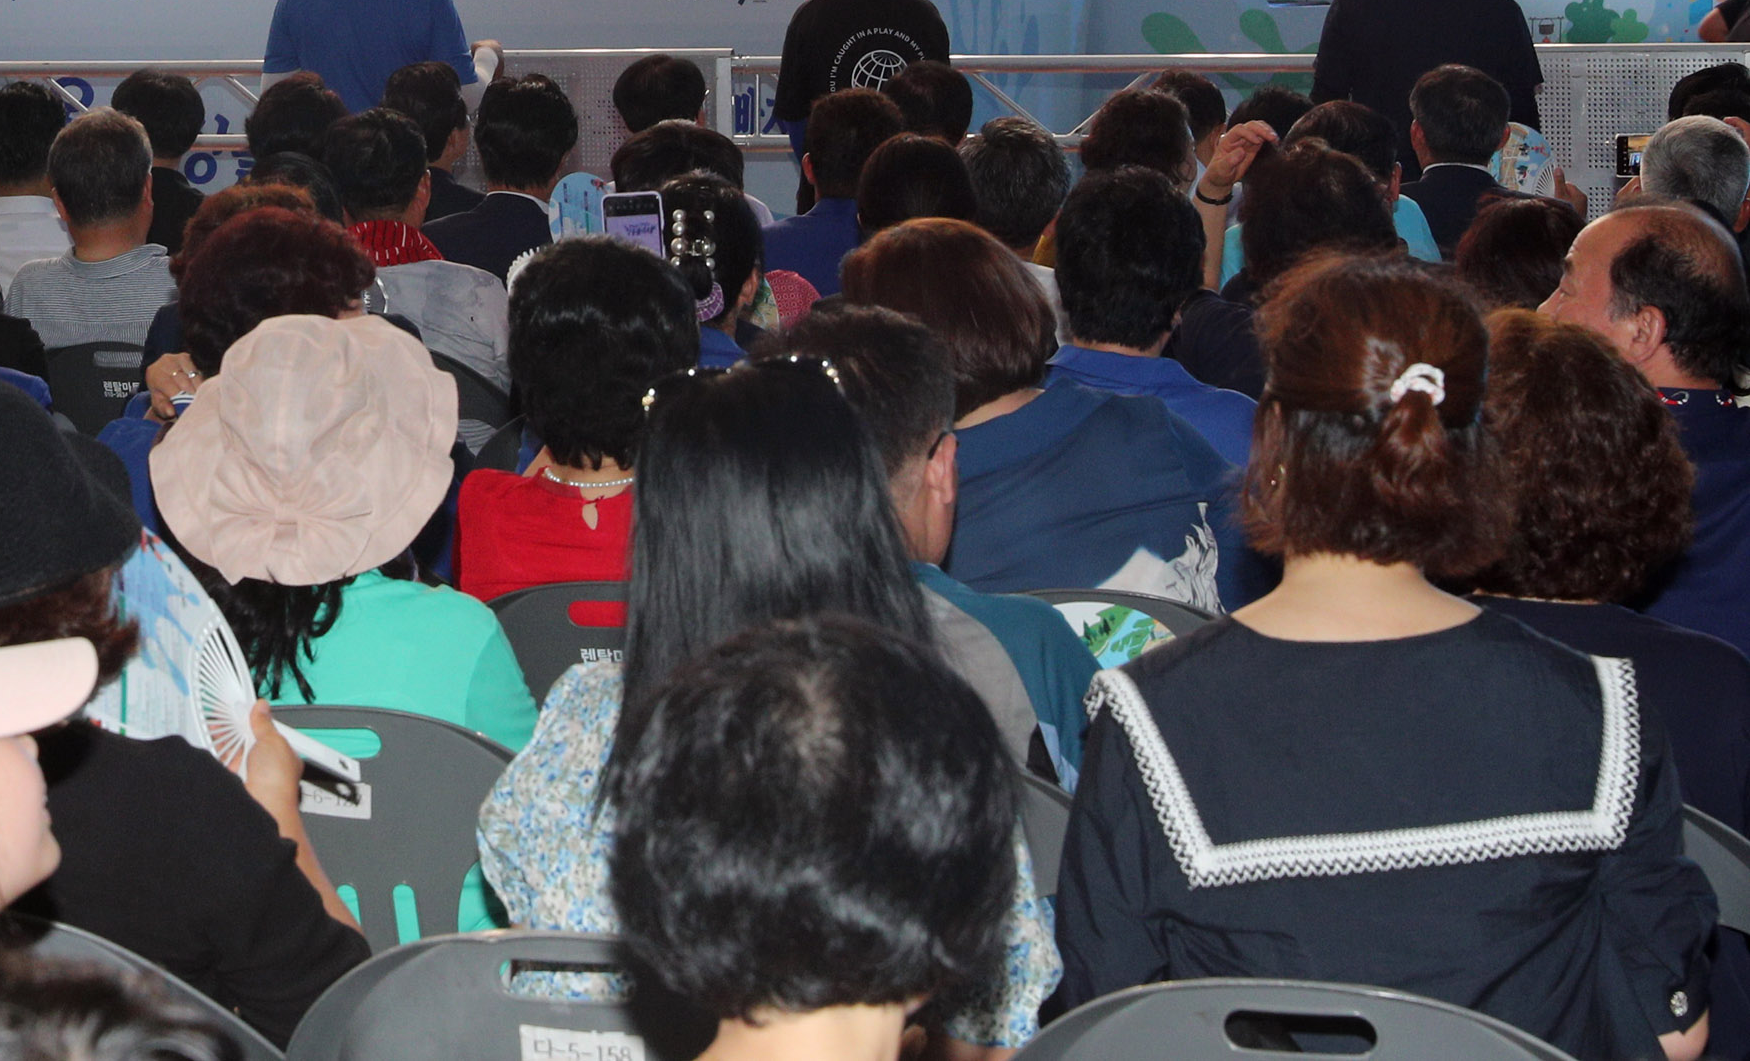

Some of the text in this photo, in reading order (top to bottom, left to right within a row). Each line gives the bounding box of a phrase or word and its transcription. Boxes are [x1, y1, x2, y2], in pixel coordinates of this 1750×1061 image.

[834, 36, 857, 65] CAUGHT
[857, 30, 867, 39] IN
[873, 27, 894, 35] PLAY
[894, 31, 910, 43] AND
[910, 40, 921, 53] MY
